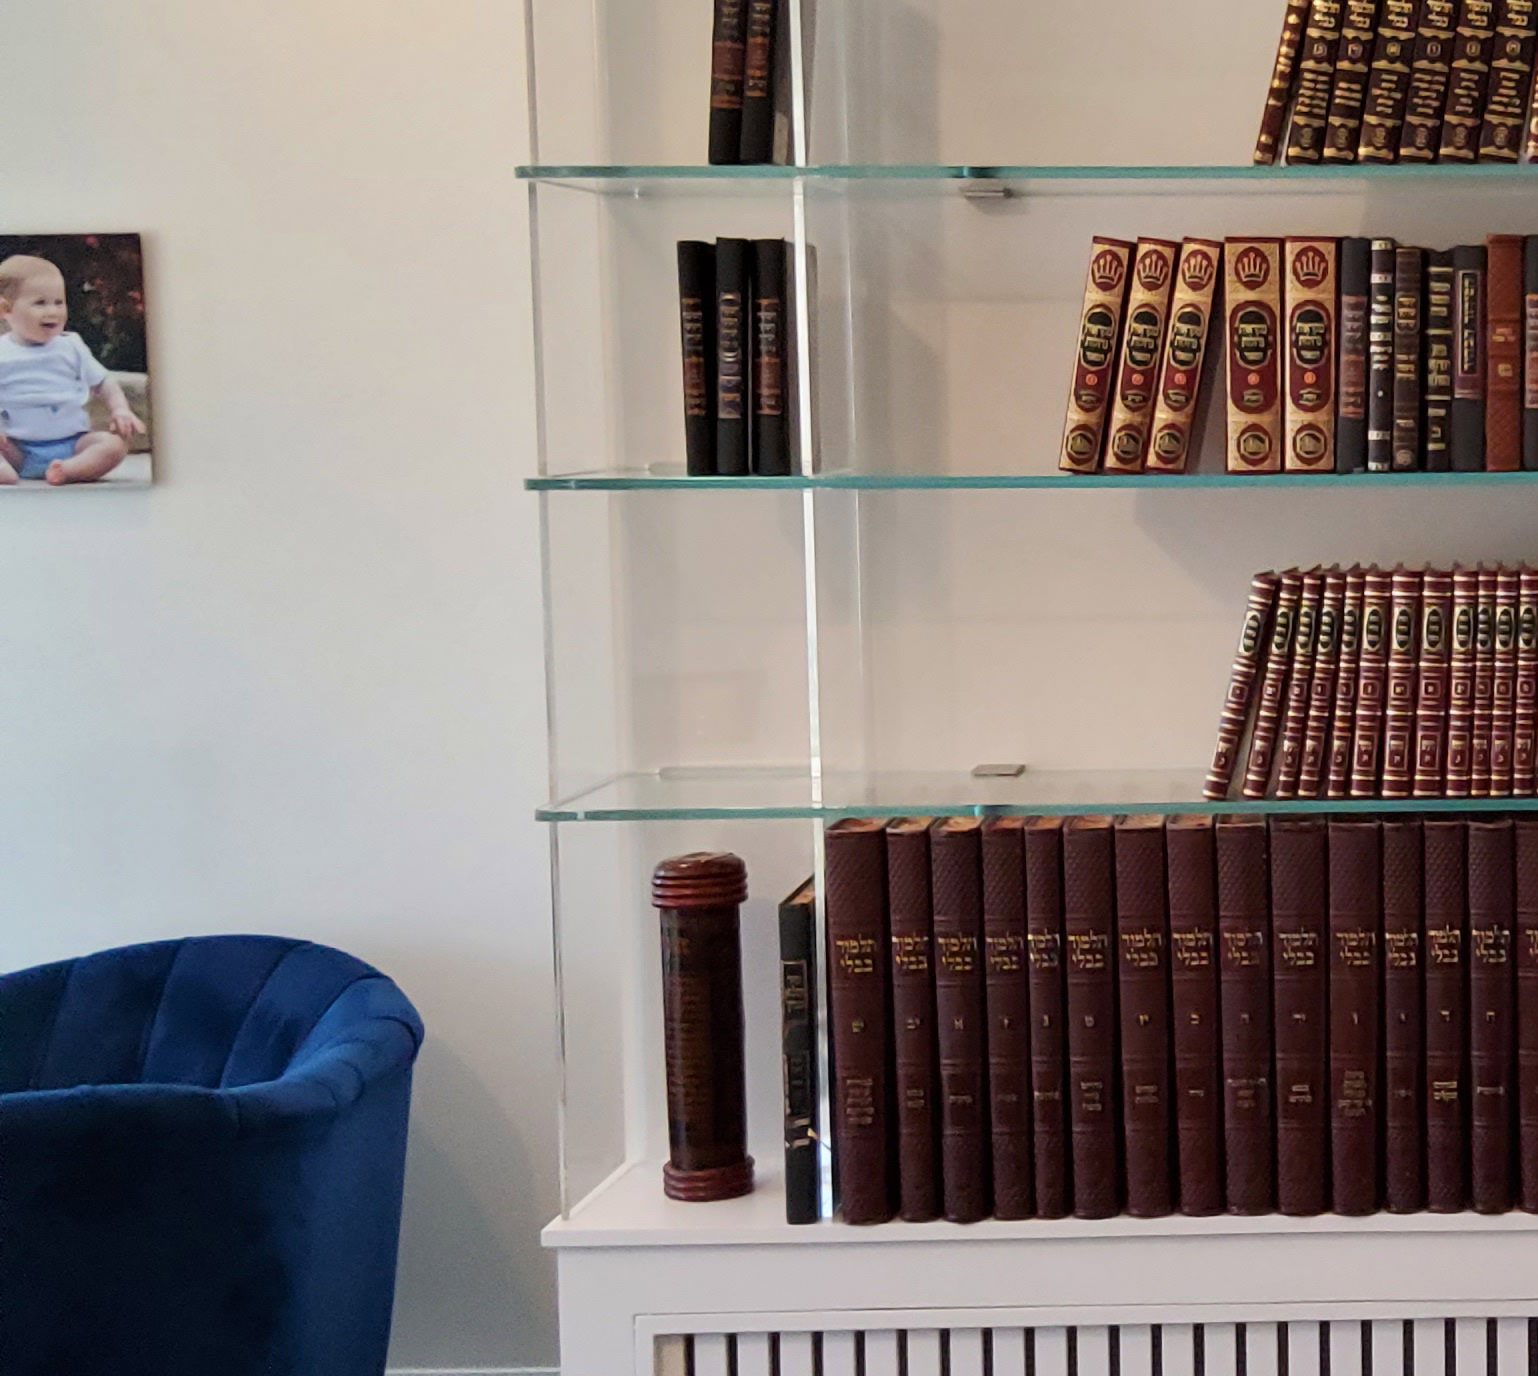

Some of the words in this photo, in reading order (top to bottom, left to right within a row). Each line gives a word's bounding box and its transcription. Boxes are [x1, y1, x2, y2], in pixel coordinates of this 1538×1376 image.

[835, 933, 876, 952] תלמוד
[892, 931, 928, 951] תלמוד
[937, 932, 977, 952] תלמוד
[986, 931, 1023, 950] תלמוד
[1067, 928, 1107, 949] תלמוד
[1122, 928, 1162, 947] תלמוד
[1172, 926, 1212, 947] תלמוד
[1278, 927, 1318, 948] תלמוד
[1335, 927, 1375, 947] תלמוד
[1385, 928, 1418, 947] תלמוד
[1427, 924, 1460, 944] תלמוד
[1471, 925, 1510, 944] תלמוד
[895, 952, 927, 969] בבלי
[941, 952, 972, 970] בבלי
[1072, 949, 1104, 968] בבלי
[1125, 948, 1158, 966] בבלי
[1177, 948, 1208, 966] בבלי
[1282, 947, 1314, 966] בבלי
[1340, 946, 1371, 966] בבלי
[1388, 947, 1416, 966] בבלי
[1430, 944, 1458, 962] בבלי
[1475, 944, 1506, 962] בבלי
[840, 954, 872, 972] בבלי
